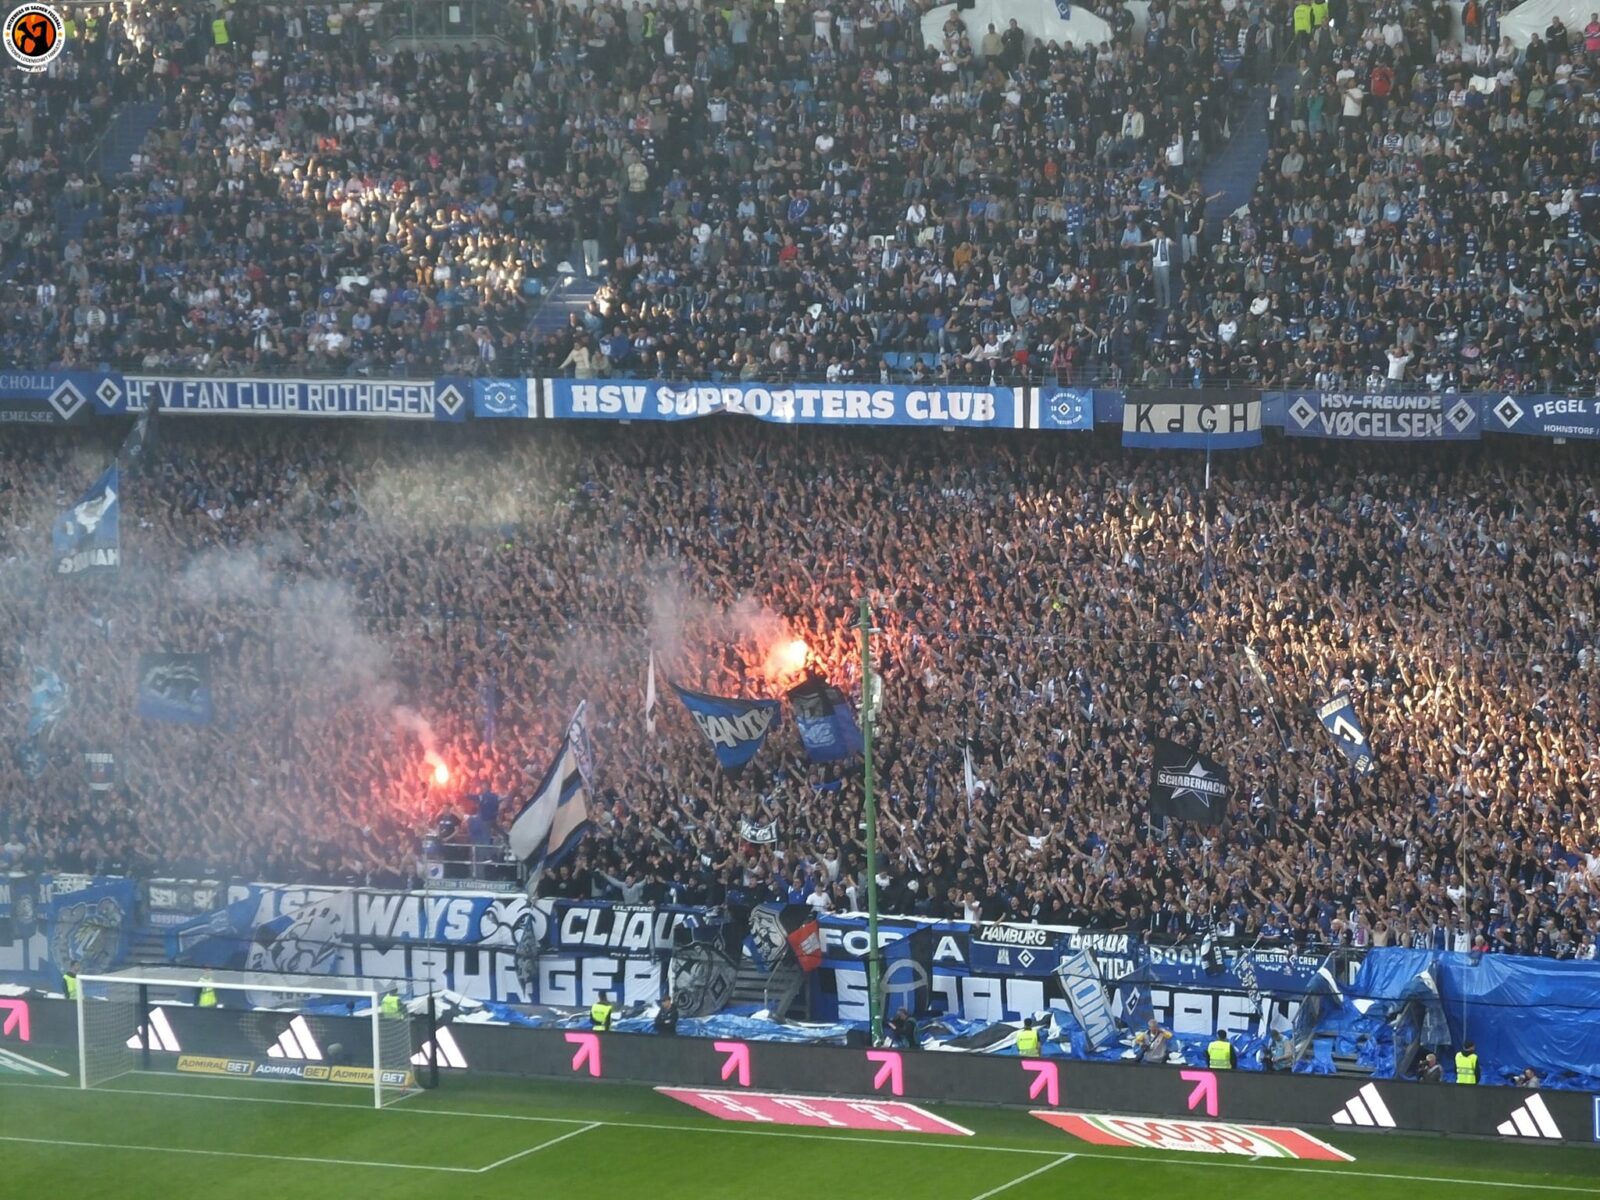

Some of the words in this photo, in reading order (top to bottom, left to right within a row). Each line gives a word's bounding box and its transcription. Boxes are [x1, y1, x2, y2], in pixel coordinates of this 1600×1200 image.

[183, 381, 229, 409] FAN
[238, 382, 299, 410] CLUB
[307, 380, 435, 413] ROTHOSEN
[571, 385, 648, 415] HSV
[656, 386, 895, 421] SUPPORTERS
[905, 391, 996, 421] CLUB
[1320, 393, 1442, 410] HSV-FREUNDE
[1533, 400, 1588, 419] PEGEL
[1544, 424, 1595, 435] HOHNSTORF
[1159, 773, 1226, 796] SCHABERNACK
[980, 925, 1047, 946] HAMBURG
[1298, 955, 1319, 966] CREW
